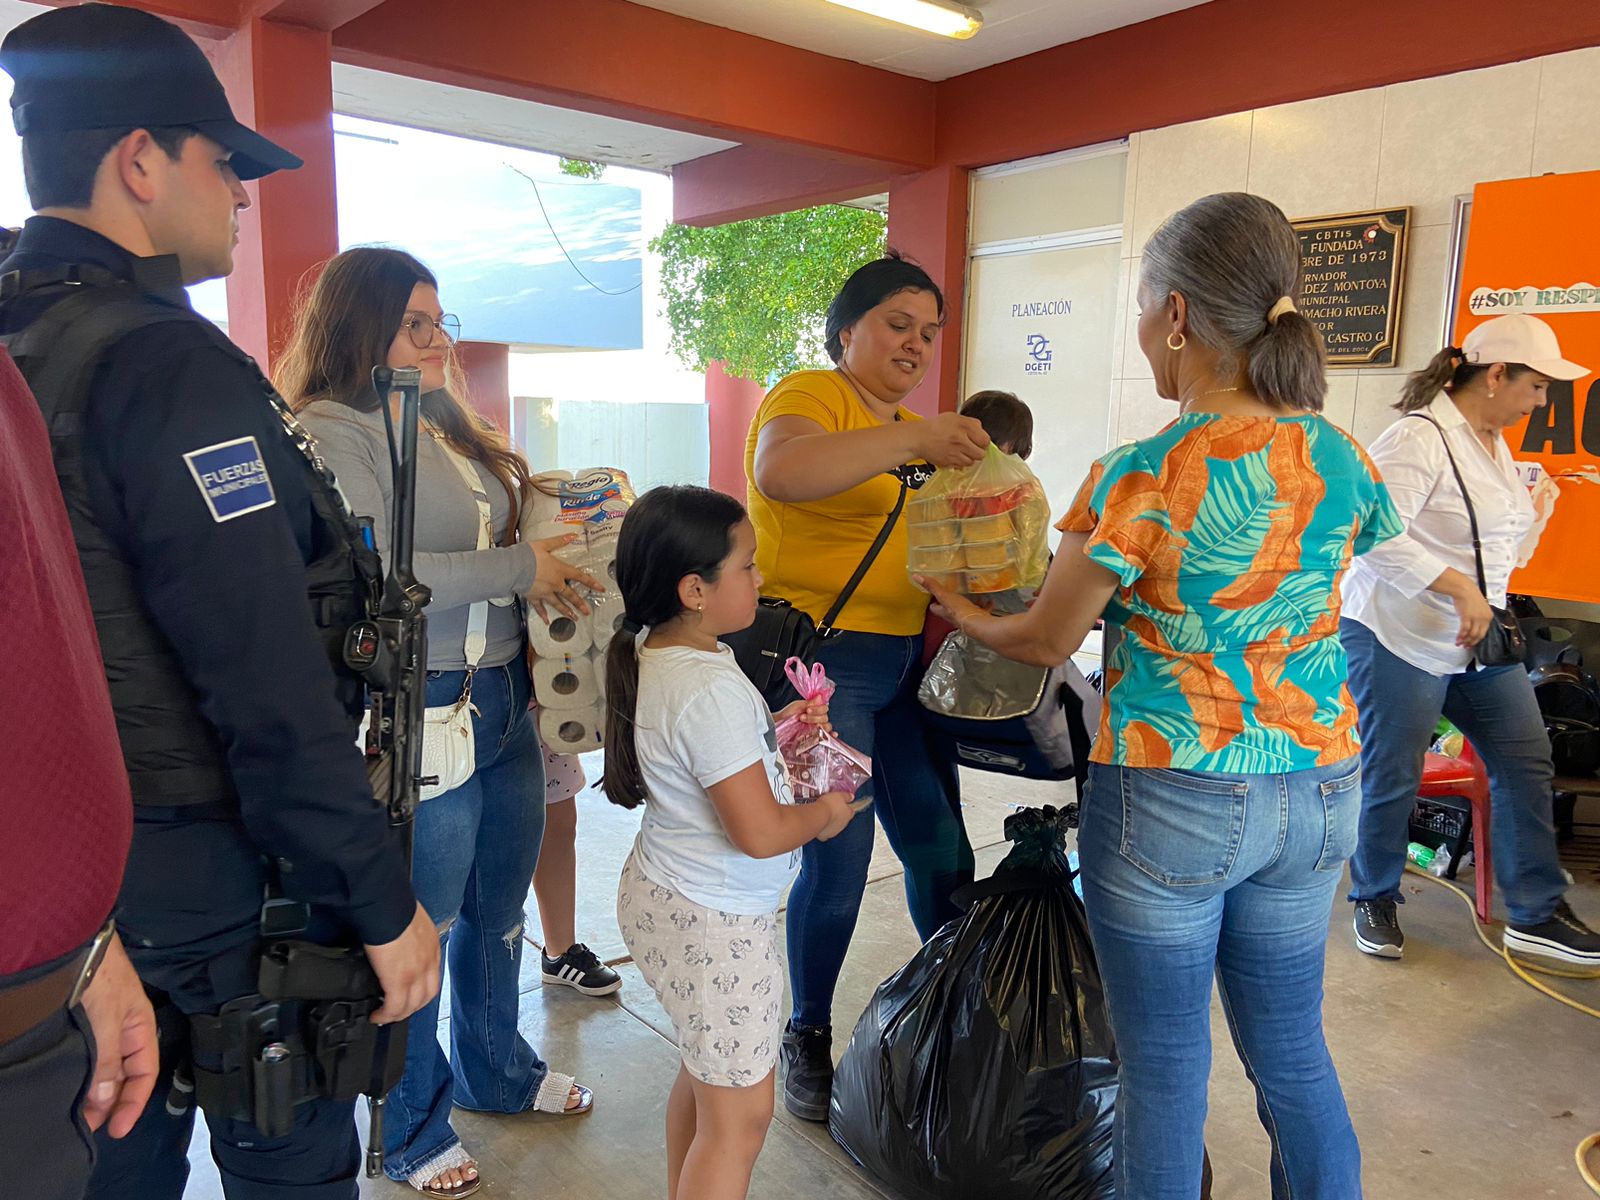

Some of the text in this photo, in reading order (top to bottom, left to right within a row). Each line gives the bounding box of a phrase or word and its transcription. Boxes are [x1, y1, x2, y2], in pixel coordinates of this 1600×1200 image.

[1316, 230, 1352, 240] CBTIS
[1311, 239, 1363, 253] FUNDADA
[1328, 254, 1345, 266] DE
[1352, 250, 1387, 263] 1973
[1303, 271, 1347, 283] RNADOR
[1301, 278, 1387, 295] DEZ MONTOYA
[1471, 291, 1528, 309] #SOY
[1012, 298, 1072, 317] PLANEACIÓN
[1345, 304, 1386, 317] RIVERA
[1327, 331, 1384, 343] CASTRO G
[1025, 362, 1051, 371] DGETI
[200, 460, 267, 488] FUERZAS
[570, 476, 609, 490] Regio
